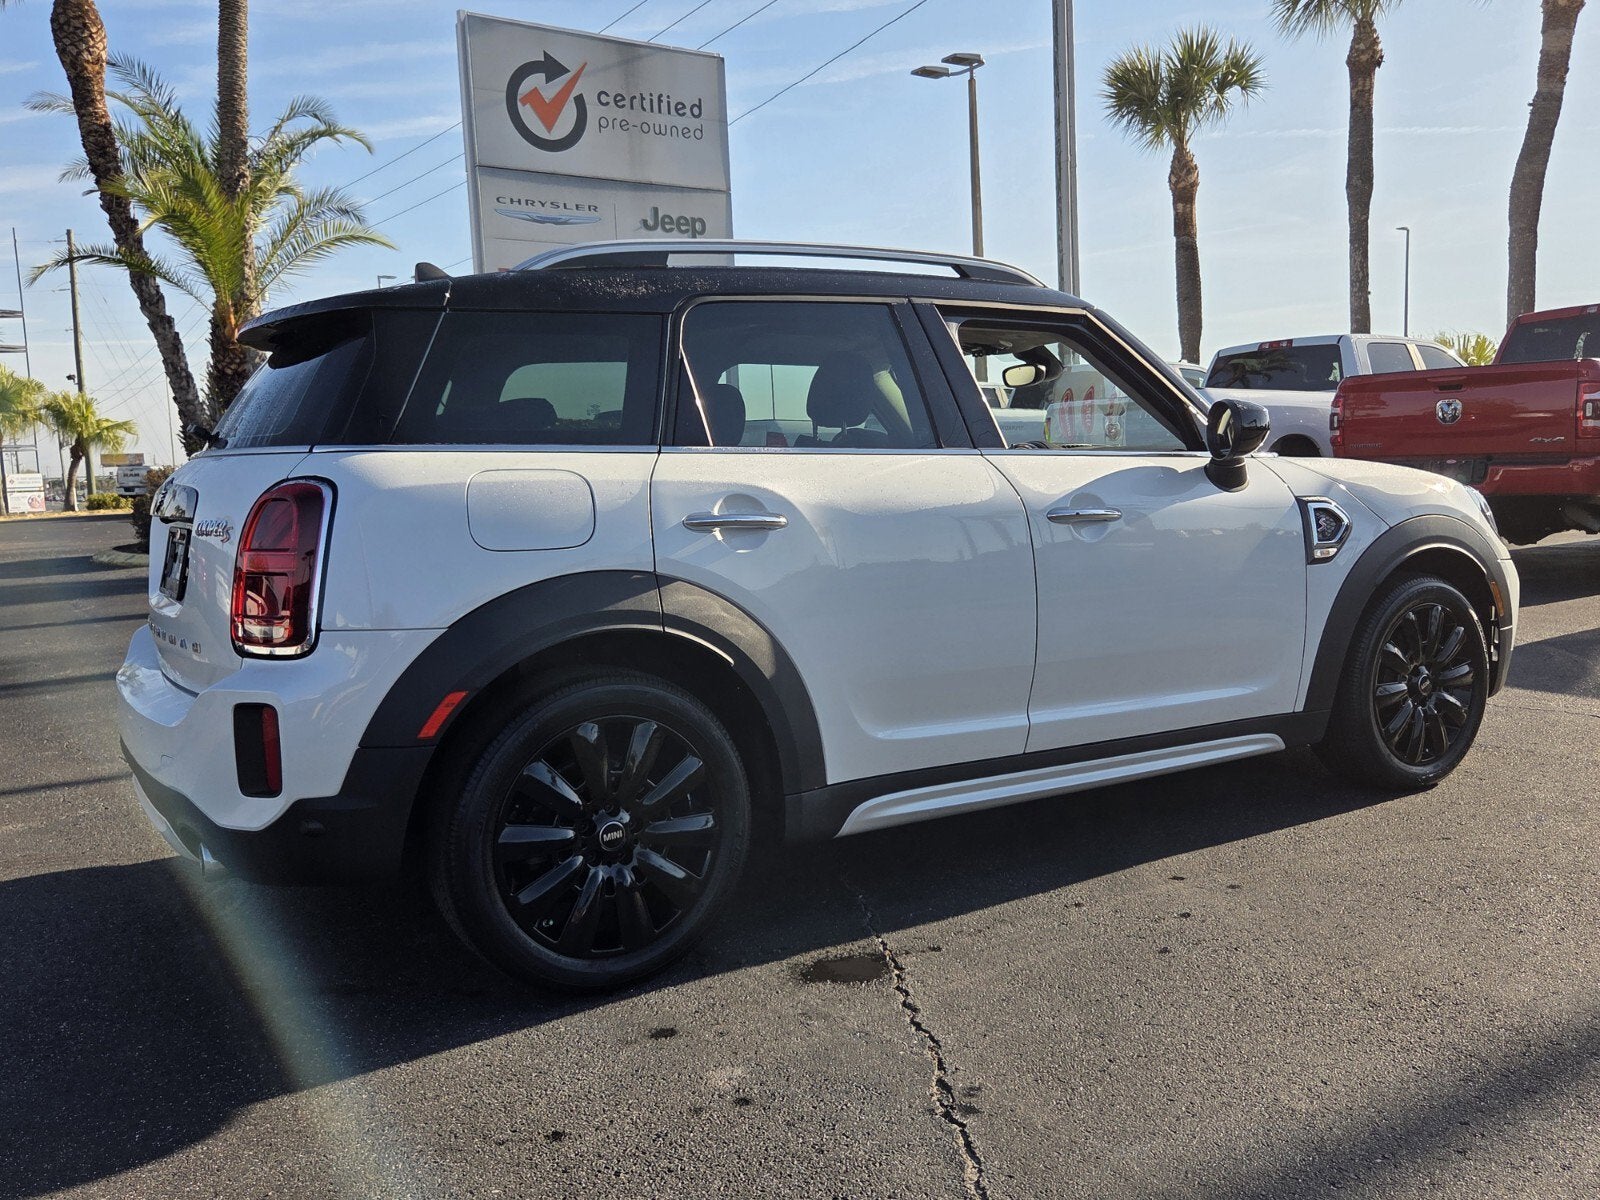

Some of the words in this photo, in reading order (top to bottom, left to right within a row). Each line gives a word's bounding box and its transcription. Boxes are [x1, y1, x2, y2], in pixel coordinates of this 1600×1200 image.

[597, 90, 703, 119] certified
[598, 116, 703, 140] pre-owned
[496, 196, 599, 213] CHRYSLER
[641, 206, 707, 239] Jeep
[603, 829, 623, 842] MINI
